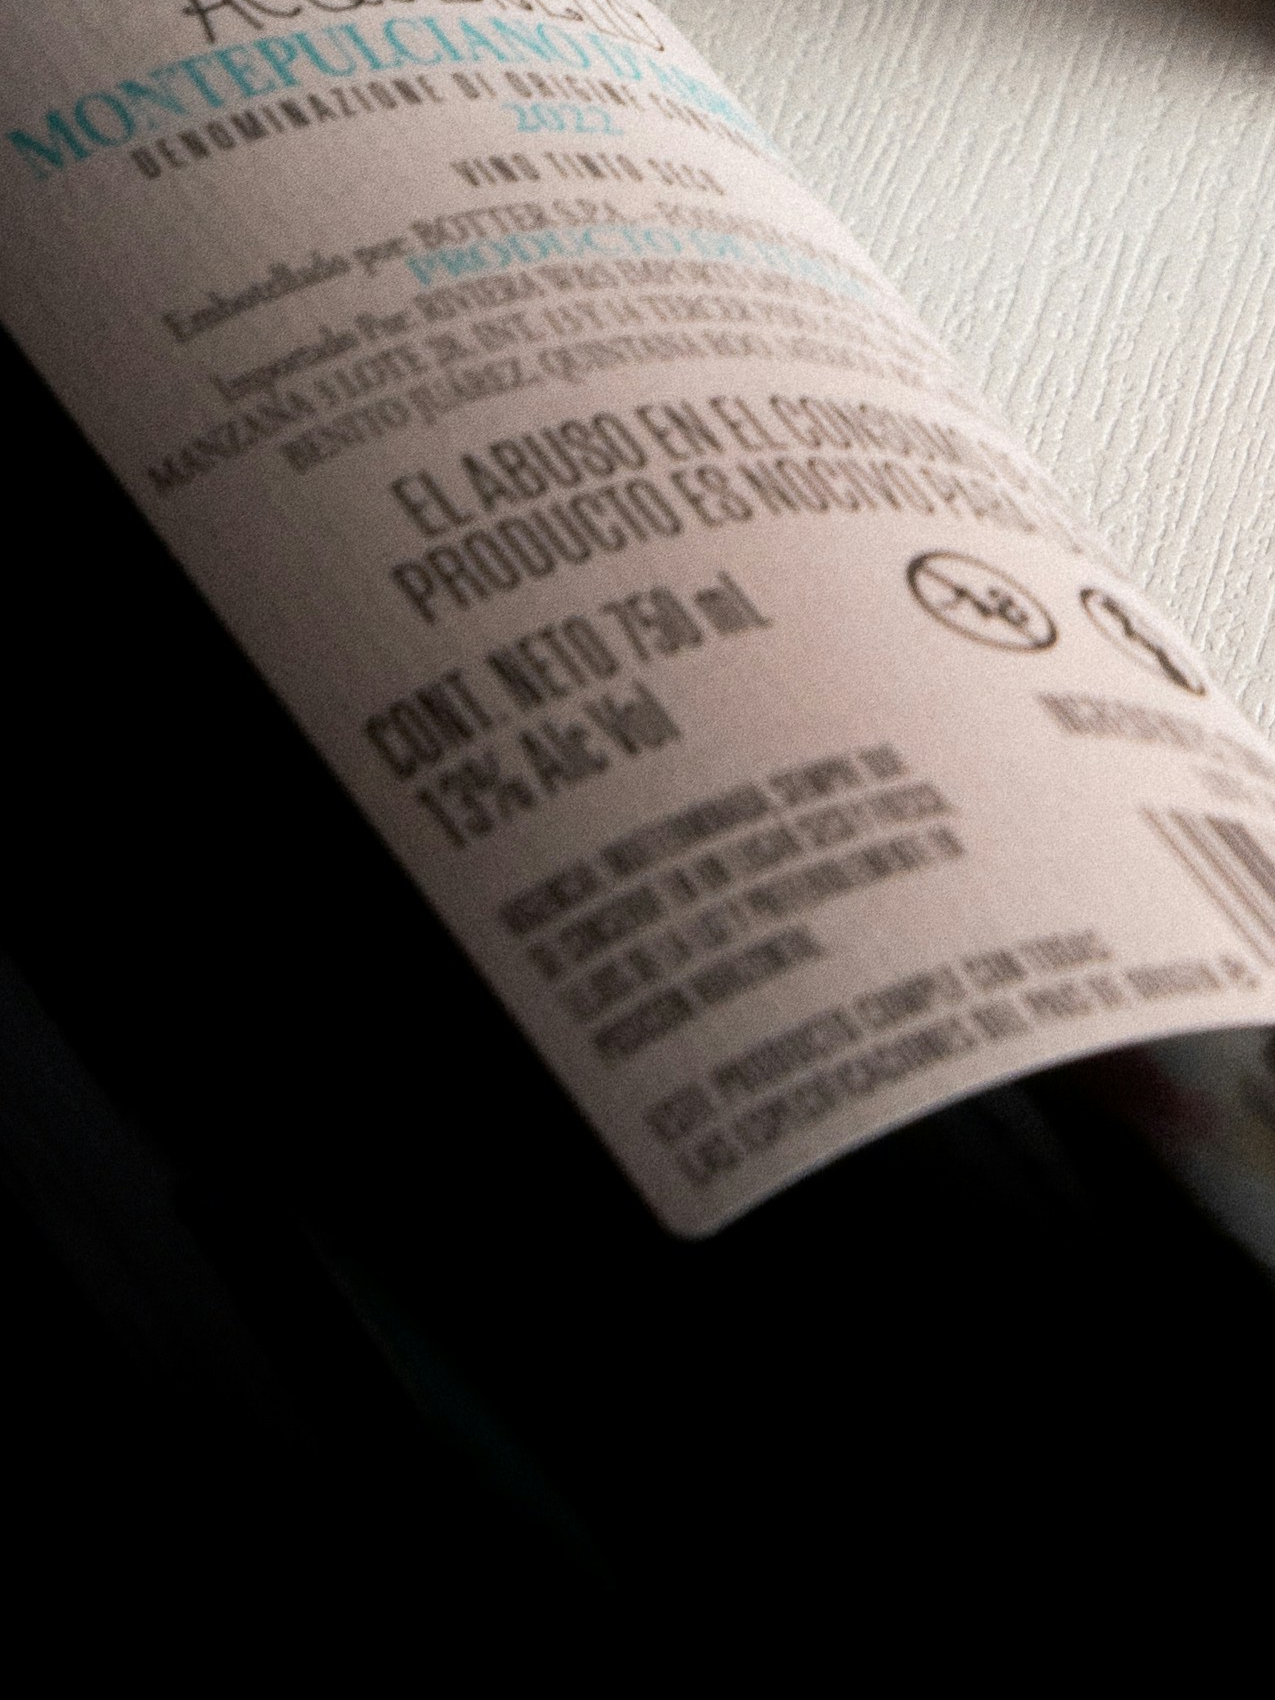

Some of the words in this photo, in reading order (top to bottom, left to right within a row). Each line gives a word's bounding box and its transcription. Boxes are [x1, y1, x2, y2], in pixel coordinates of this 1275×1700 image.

[4, 15, 591, 182] MONTEPULCIANO
[131, 75, 438, 180] DENOMINAZIONE
[451, 70, 498, 100] DI
[387, 453, 470, 539] EL
[459, 407, 650, 520] ABUSO
[634, 396, 722, 462] EN
[709, 395, 788, 451] EL
[387, 472, 685, 627] PRODUCTO
[673, 461, 754, 529] ES
[485, 613, 621, 710] NETO
